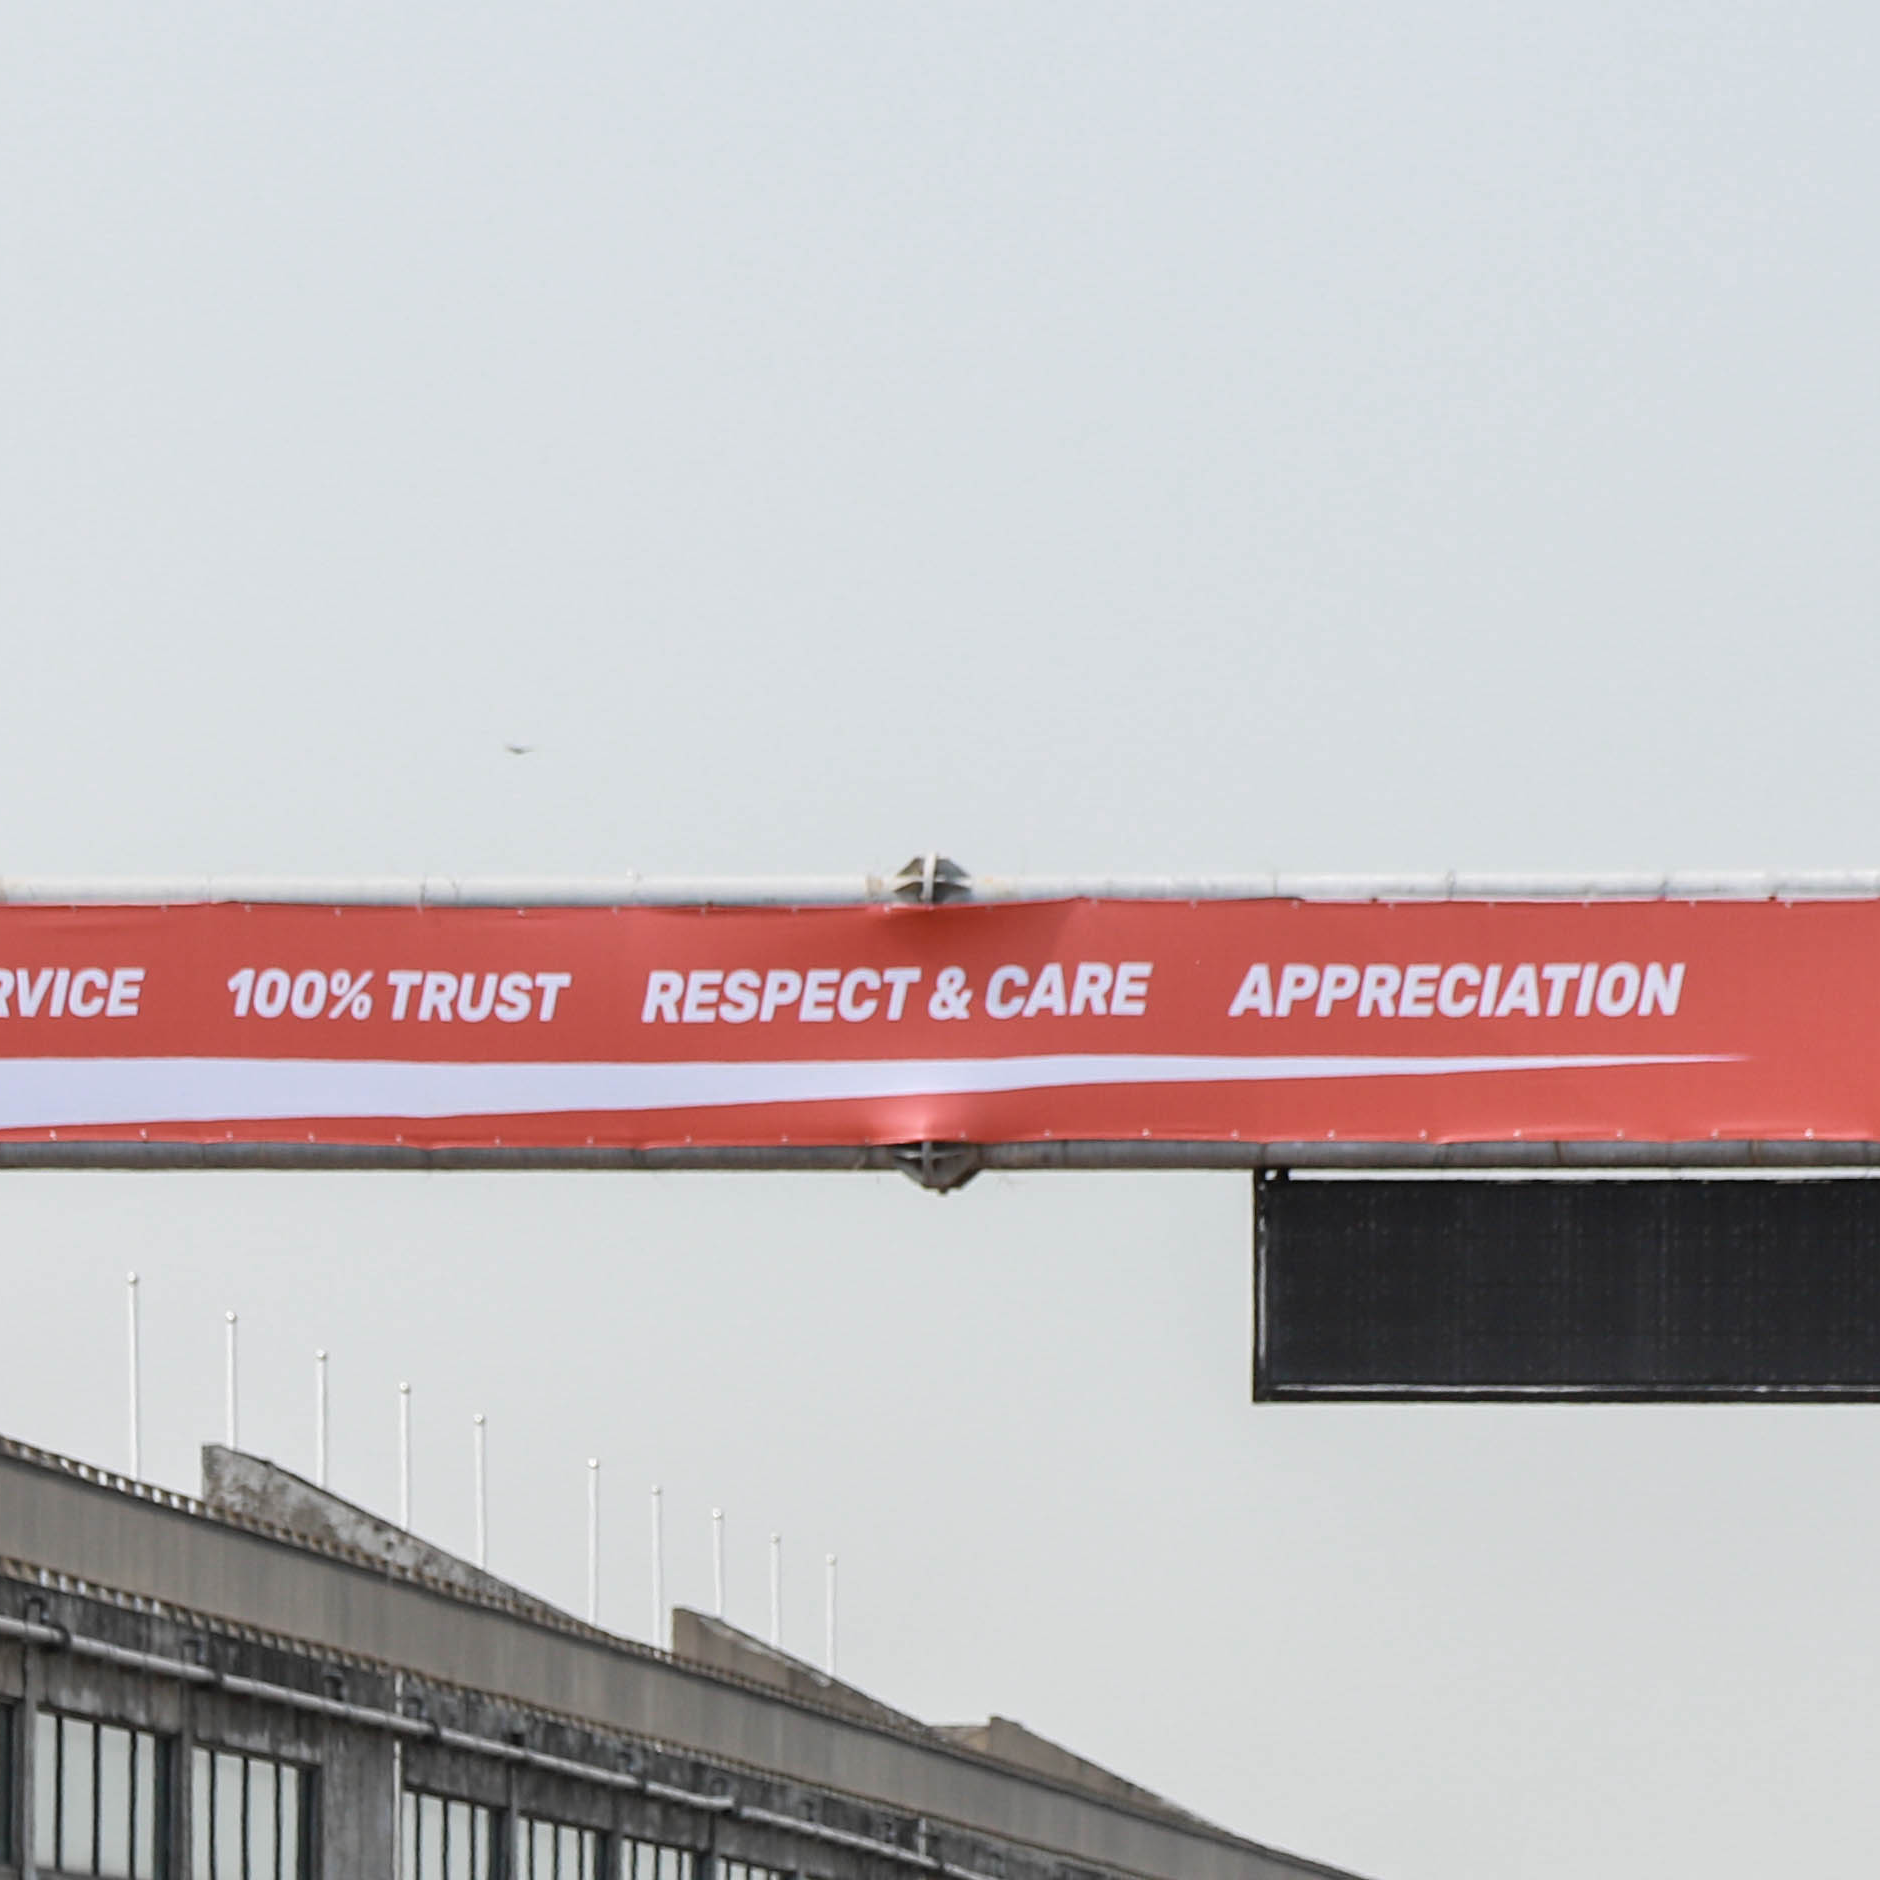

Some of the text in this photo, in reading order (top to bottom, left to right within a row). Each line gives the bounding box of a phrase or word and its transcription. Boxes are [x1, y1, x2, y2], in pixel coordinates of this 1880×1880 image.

[226, 968, 574, 1024] 100% TRUST
[641, 962, 1155, 1025] RESPECT & CARE
[1227, 962, 1687, 1019] APPRECIATION
